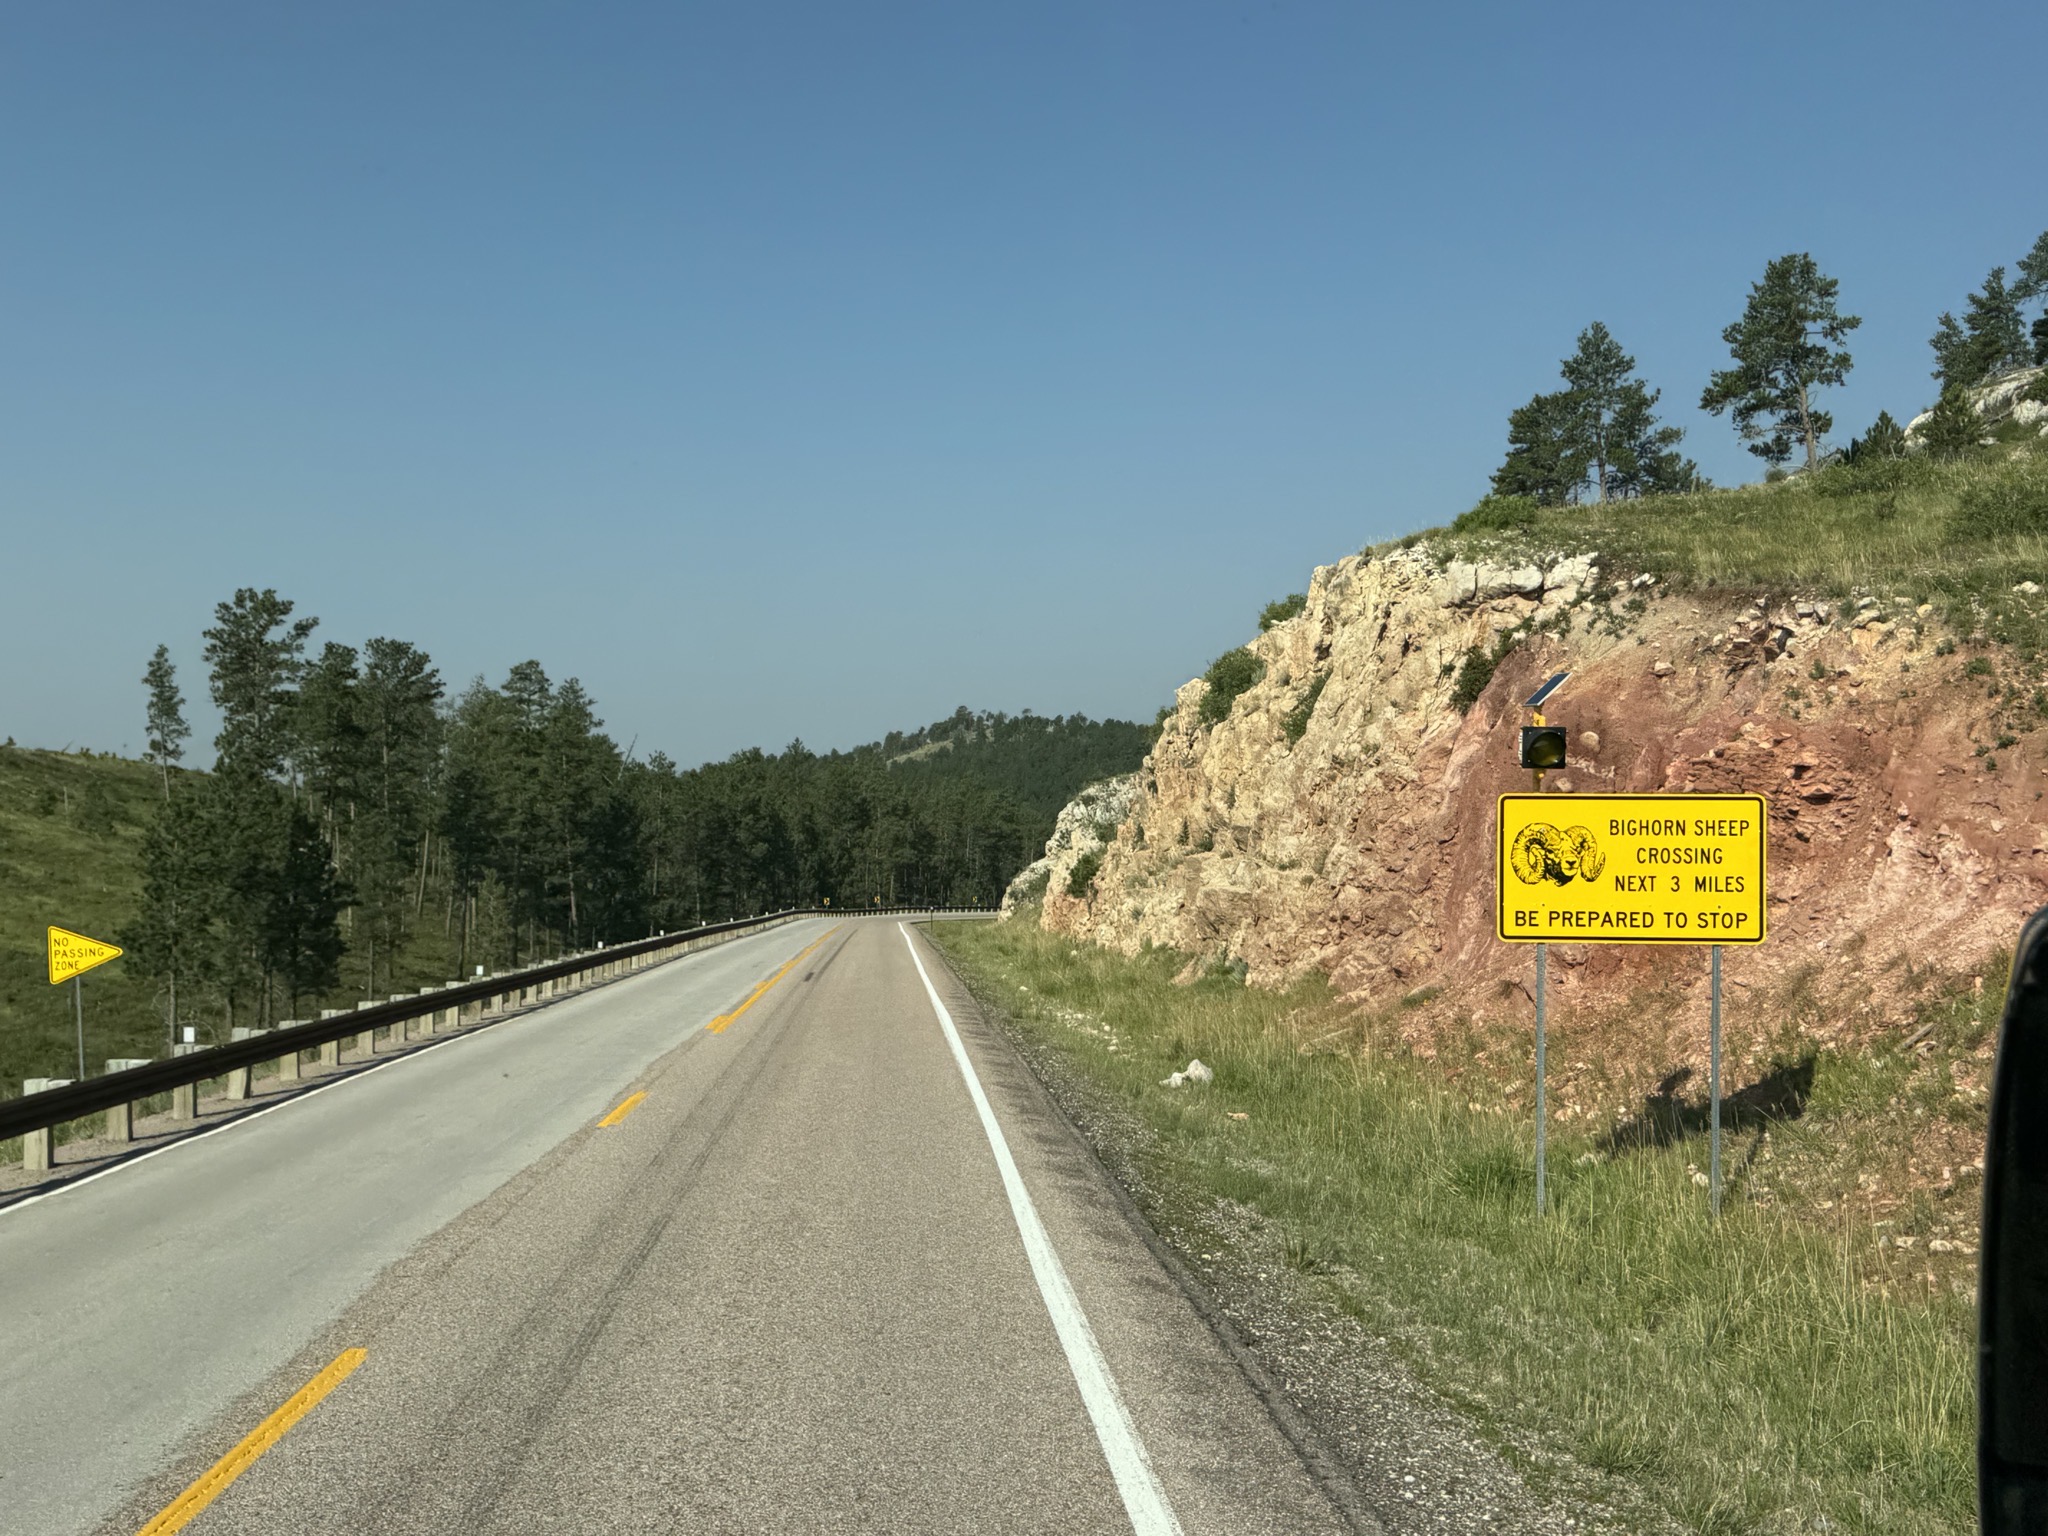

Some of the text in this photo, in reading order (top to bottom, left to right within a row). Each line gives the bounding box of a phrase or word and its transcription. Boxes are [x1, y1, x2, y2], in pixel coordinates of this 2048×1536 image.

[1609, 819, 1750, 837] BIGHORN SHEEP
[1636, 847, 1723, 865] CROSSING
[1615, 875, 1745, 893] NEXT 3 MILES
[1515, 910, 1748, 929] BE PREPARED TO STOP
[53, 937, 69, 948] NO
[54, 947, 105, 959] PASSING
[54, 960, 80, 971] ZONE
